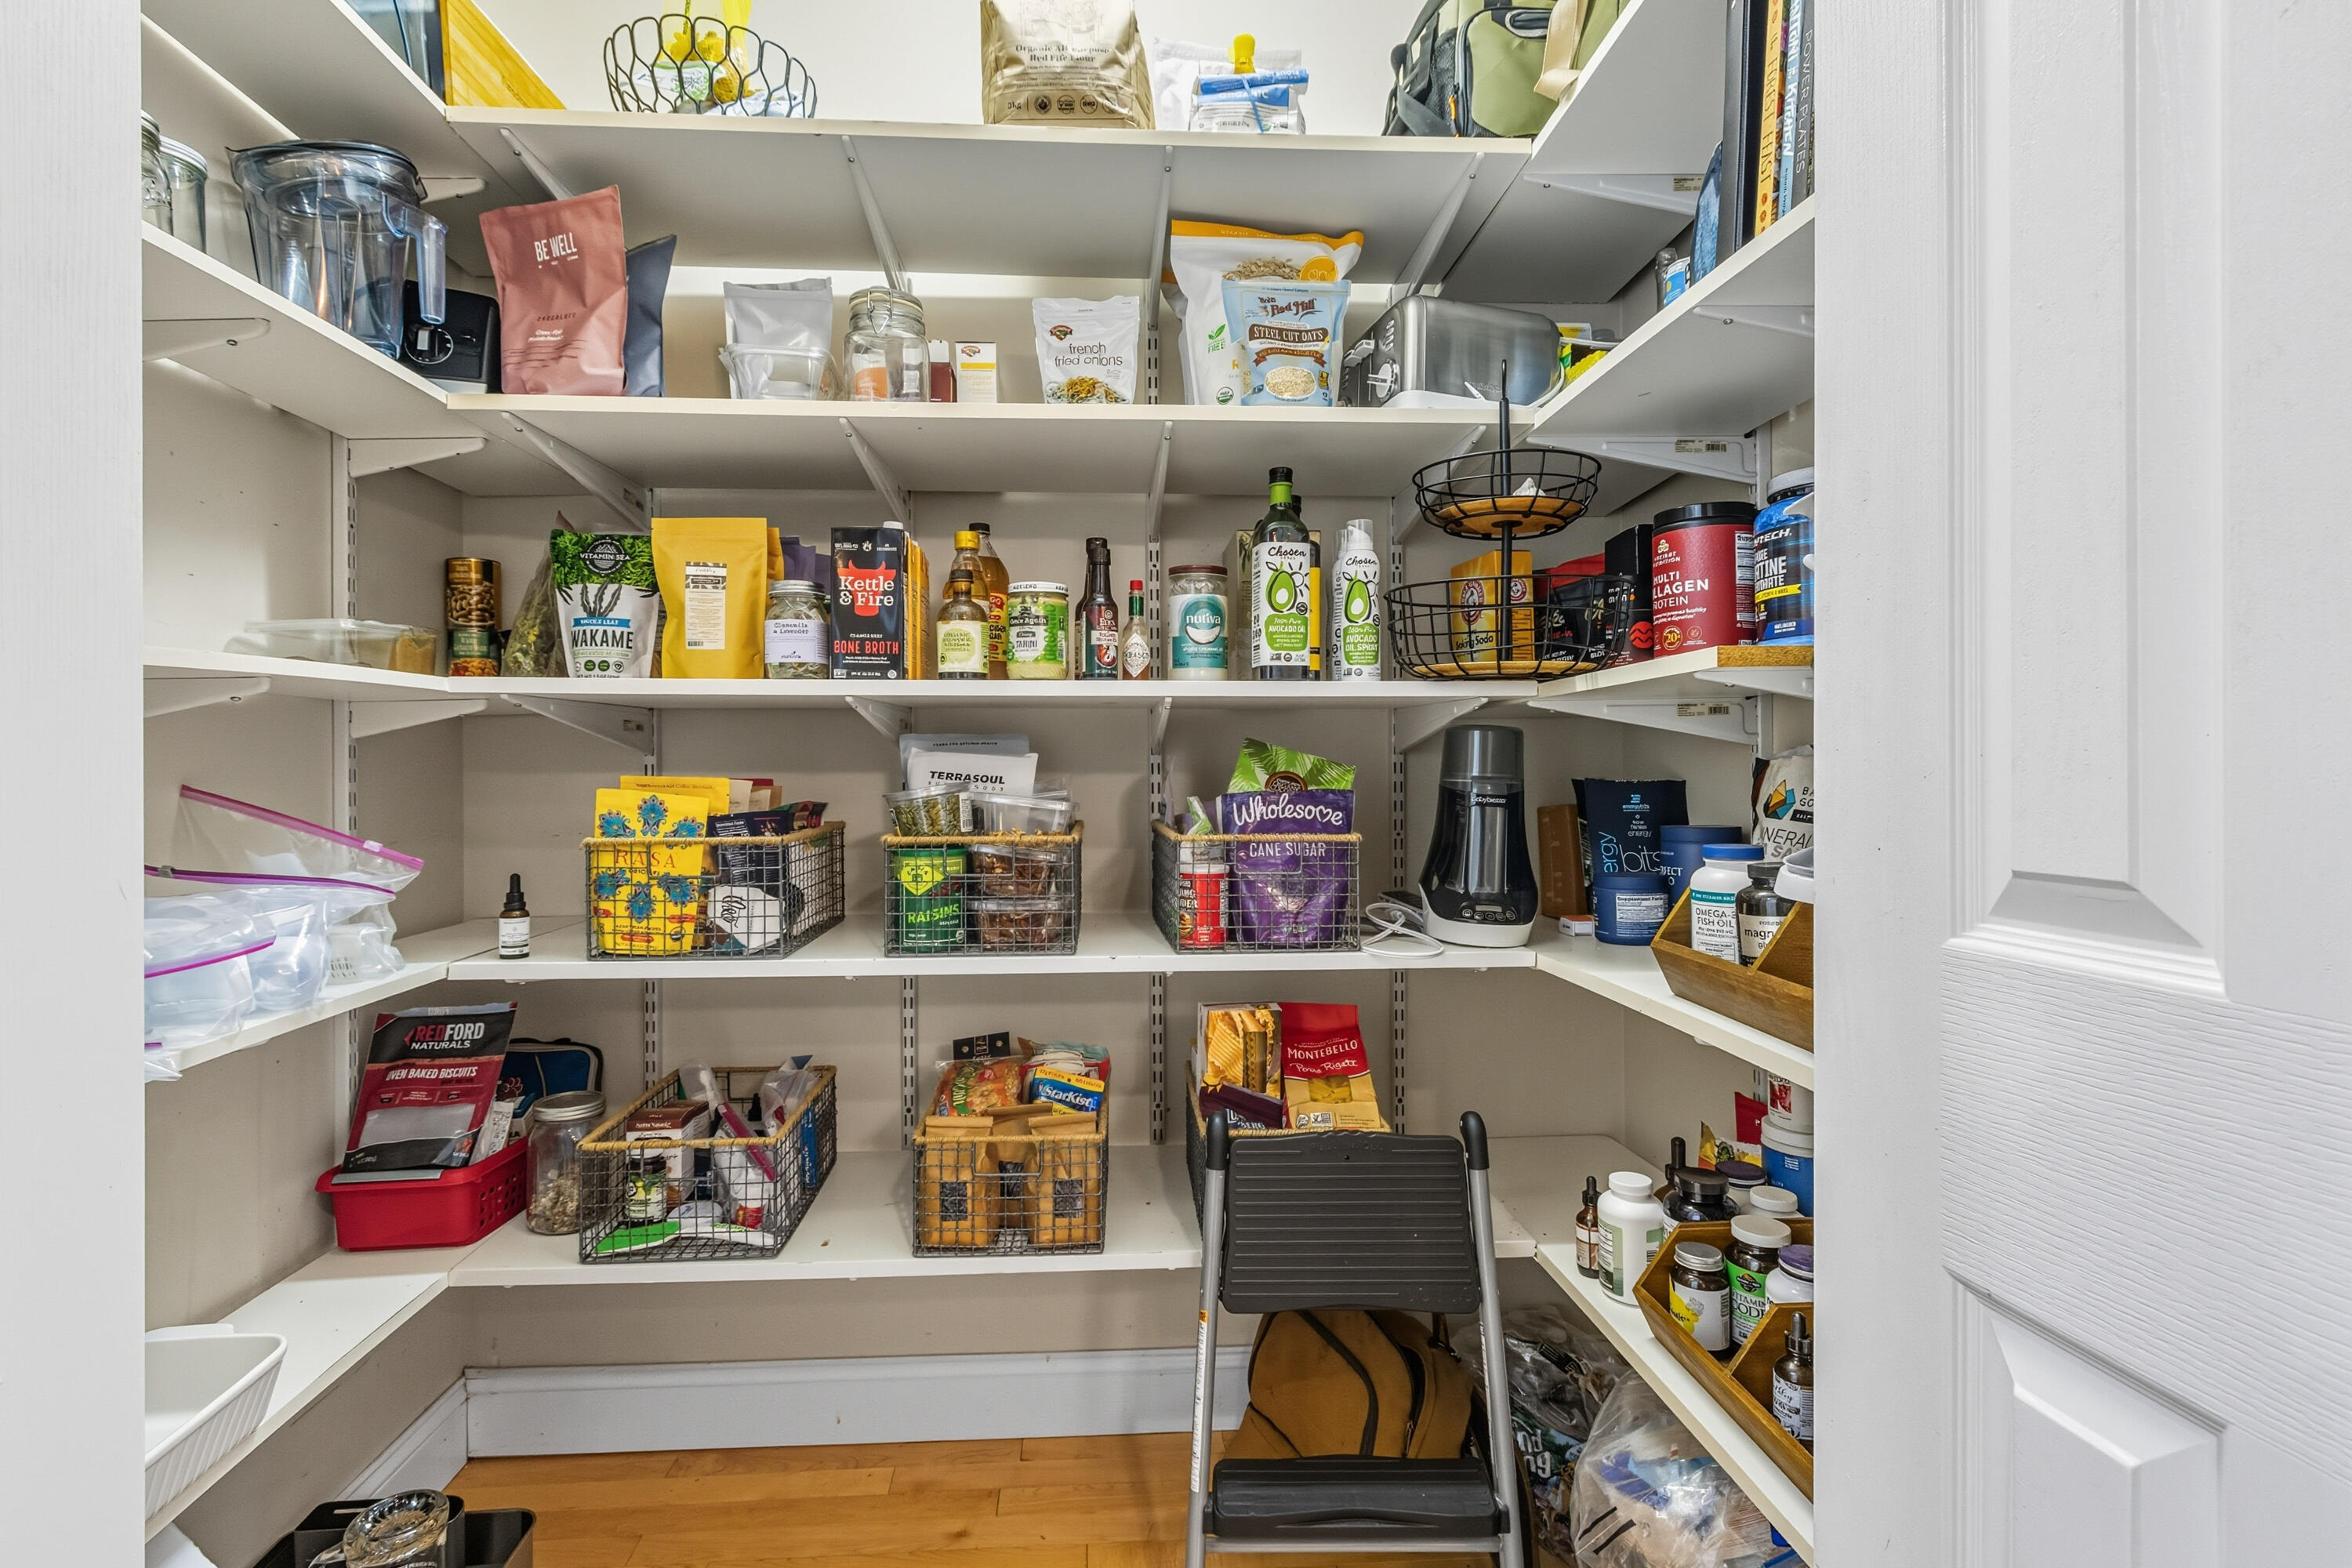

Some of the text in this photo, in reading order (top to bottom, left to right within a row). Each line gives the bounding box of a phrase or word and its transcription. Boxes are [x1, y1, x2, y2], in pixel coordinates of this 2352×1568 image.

[1029, 53, 1048, 62] Red
[1762, 56, 1778, 122] FOREST
[1795, 29, 1813, 173] POWER PLATES
[1783, 82, 1798, 156] KITCHEN
[1760, 131, 1773, 183] FEAST
[534, 231, 577, 262] BE WELL
[1254, 326, 1323, 342] STEEL CUT OATS
[1069, 342, 1106, 354] french
[1054, 354, 1123, 368] fried onions
[1268, 545, 1307, 557] Chosen
[1345, 556, 1377, 566] Chosen
[839, 575, 894, 591] Kettle
[1653, 579, 1709, 599] LLAGEN
[840, 591, 894, 607] & Fire
[1653, 595, 1689, 610] ROTEIN
[1025, 617, 1047, 626] Again
[1186, 613, 1221, 624] nutiva
[571, 628, 633, 649] WAKAME
[1346, 634, 1377, 643] AVOCADO
[1475, 633, 1494, 645] Soda
[833, 640, 899, 655] BONE BROTH
[930, 771, 1006, 785] TERRASOUL
[1233, 793, 1344, 826] Wholesome
[1250, 842, 1327, 858] CANE SUGAR
[615, 849, 676, 869] RASA
[908, 903, 960, 924] RAISINS
[1695, 907, 1736, 919] OMEGA-3
[1697, 916, 1735, 928] FISH OIL
[416, 1022, 485, 1041] REDFORD
[410, 1040, 471, 1050] NATURALS
[1287, 1039, 1359, 1060] MONTEBELLO
[386, 1066, 478, 1080] OVEN BAKED BISCUITS
[1044, 1085, 1091, 1107] StarKist
[1732, 1289, 1766, 1305] VITAMIN
